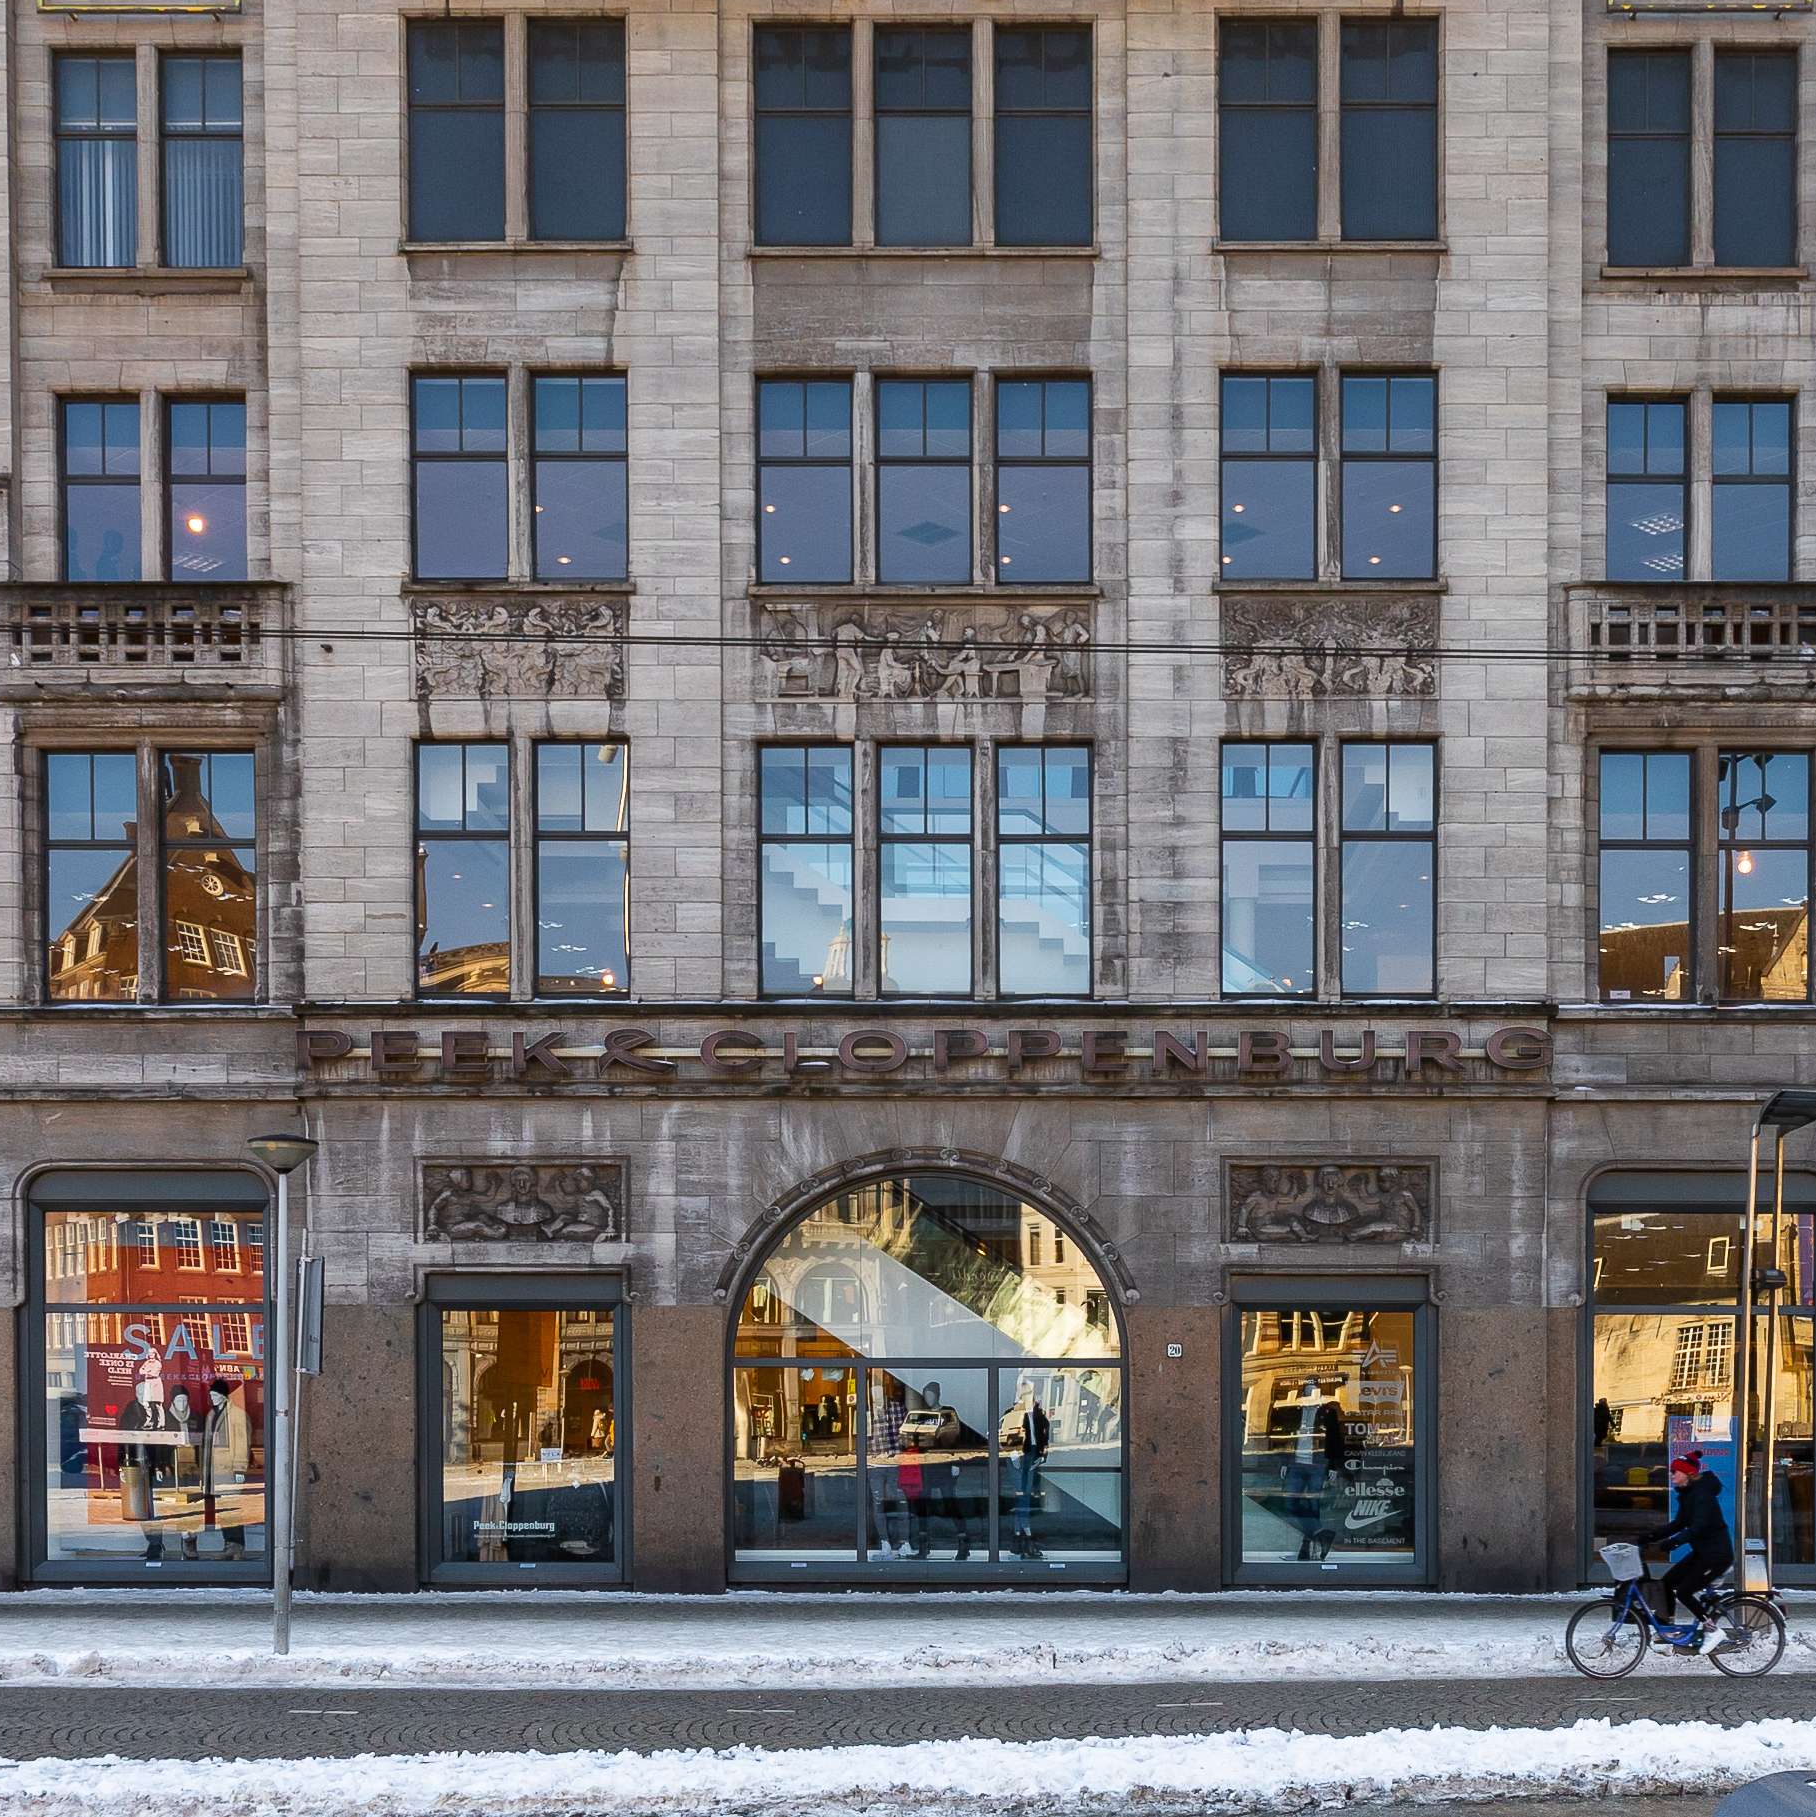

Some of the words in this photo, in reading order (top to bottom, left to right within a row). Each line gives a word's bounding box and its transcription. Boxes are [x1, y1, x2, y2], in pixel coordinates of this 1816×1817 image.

[295, 1028, 570, 1072] PEEK
[598, 1028, 675, 1072] &
[699, 1027, 1556, 1072] CLOPPENBURG
[1344, 1482, 1405, 1497] ellesse
[1353, 1499, 1392, 1517] NIKE
